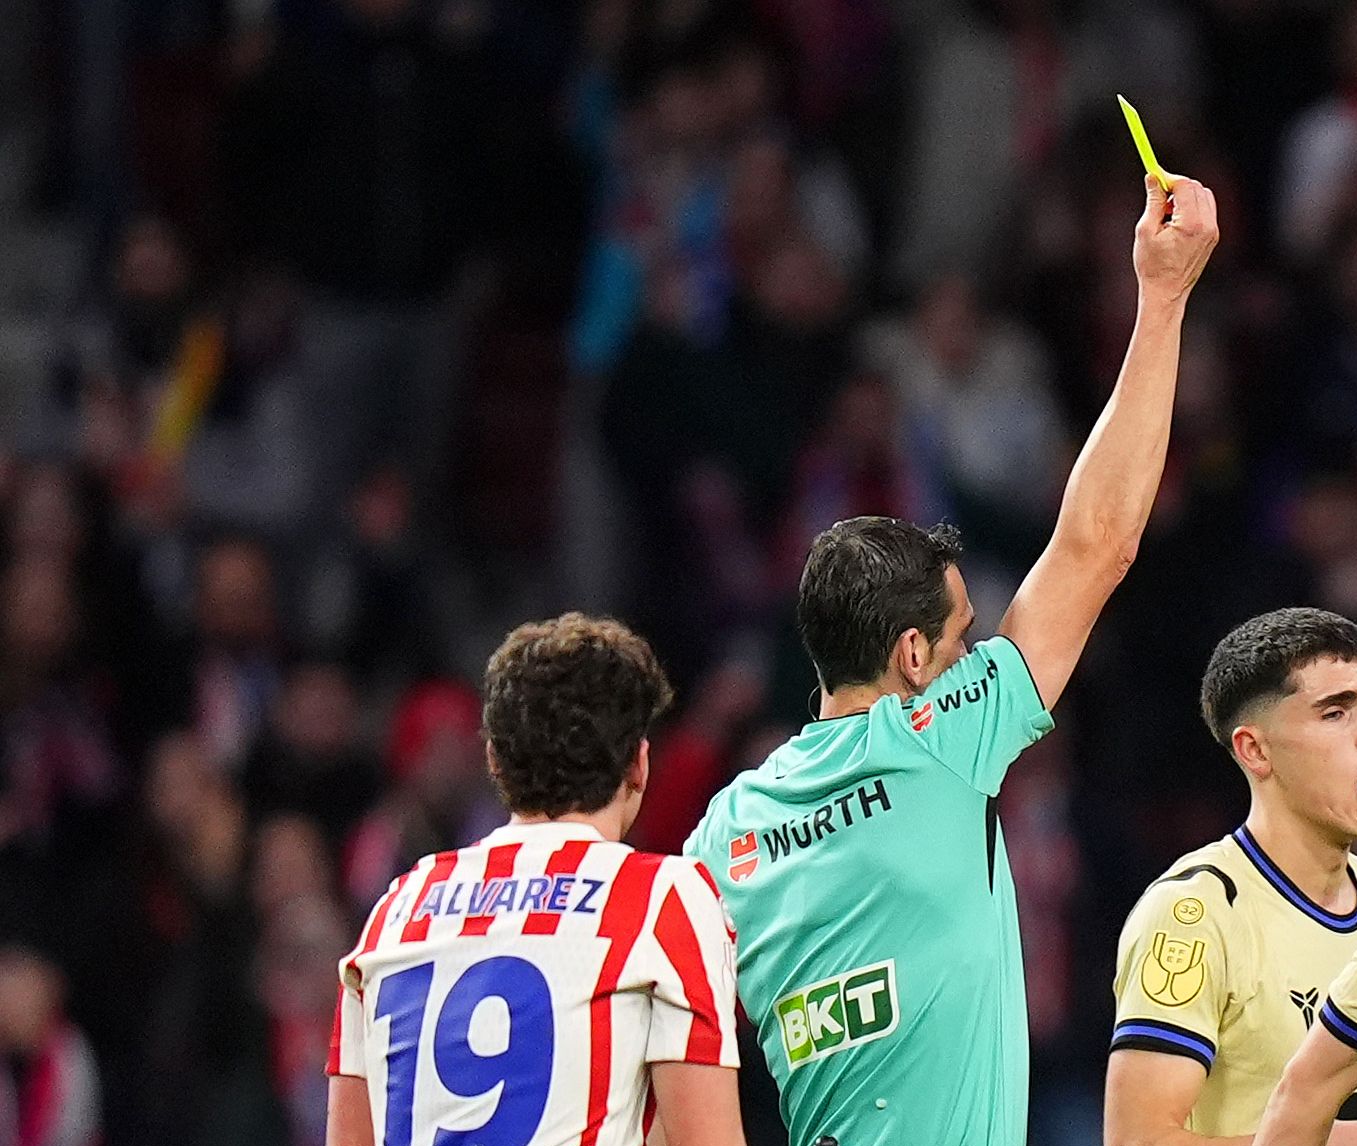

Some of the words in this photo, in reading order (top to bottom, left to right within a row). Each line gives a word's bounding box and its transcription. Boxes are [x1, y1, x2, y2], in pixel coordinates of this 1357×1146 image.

[763, 779, 892, 863] WÜRTH
[417, 875, 605, 917] ALVAREZ
[781, 974, 888, 1057] BKT
